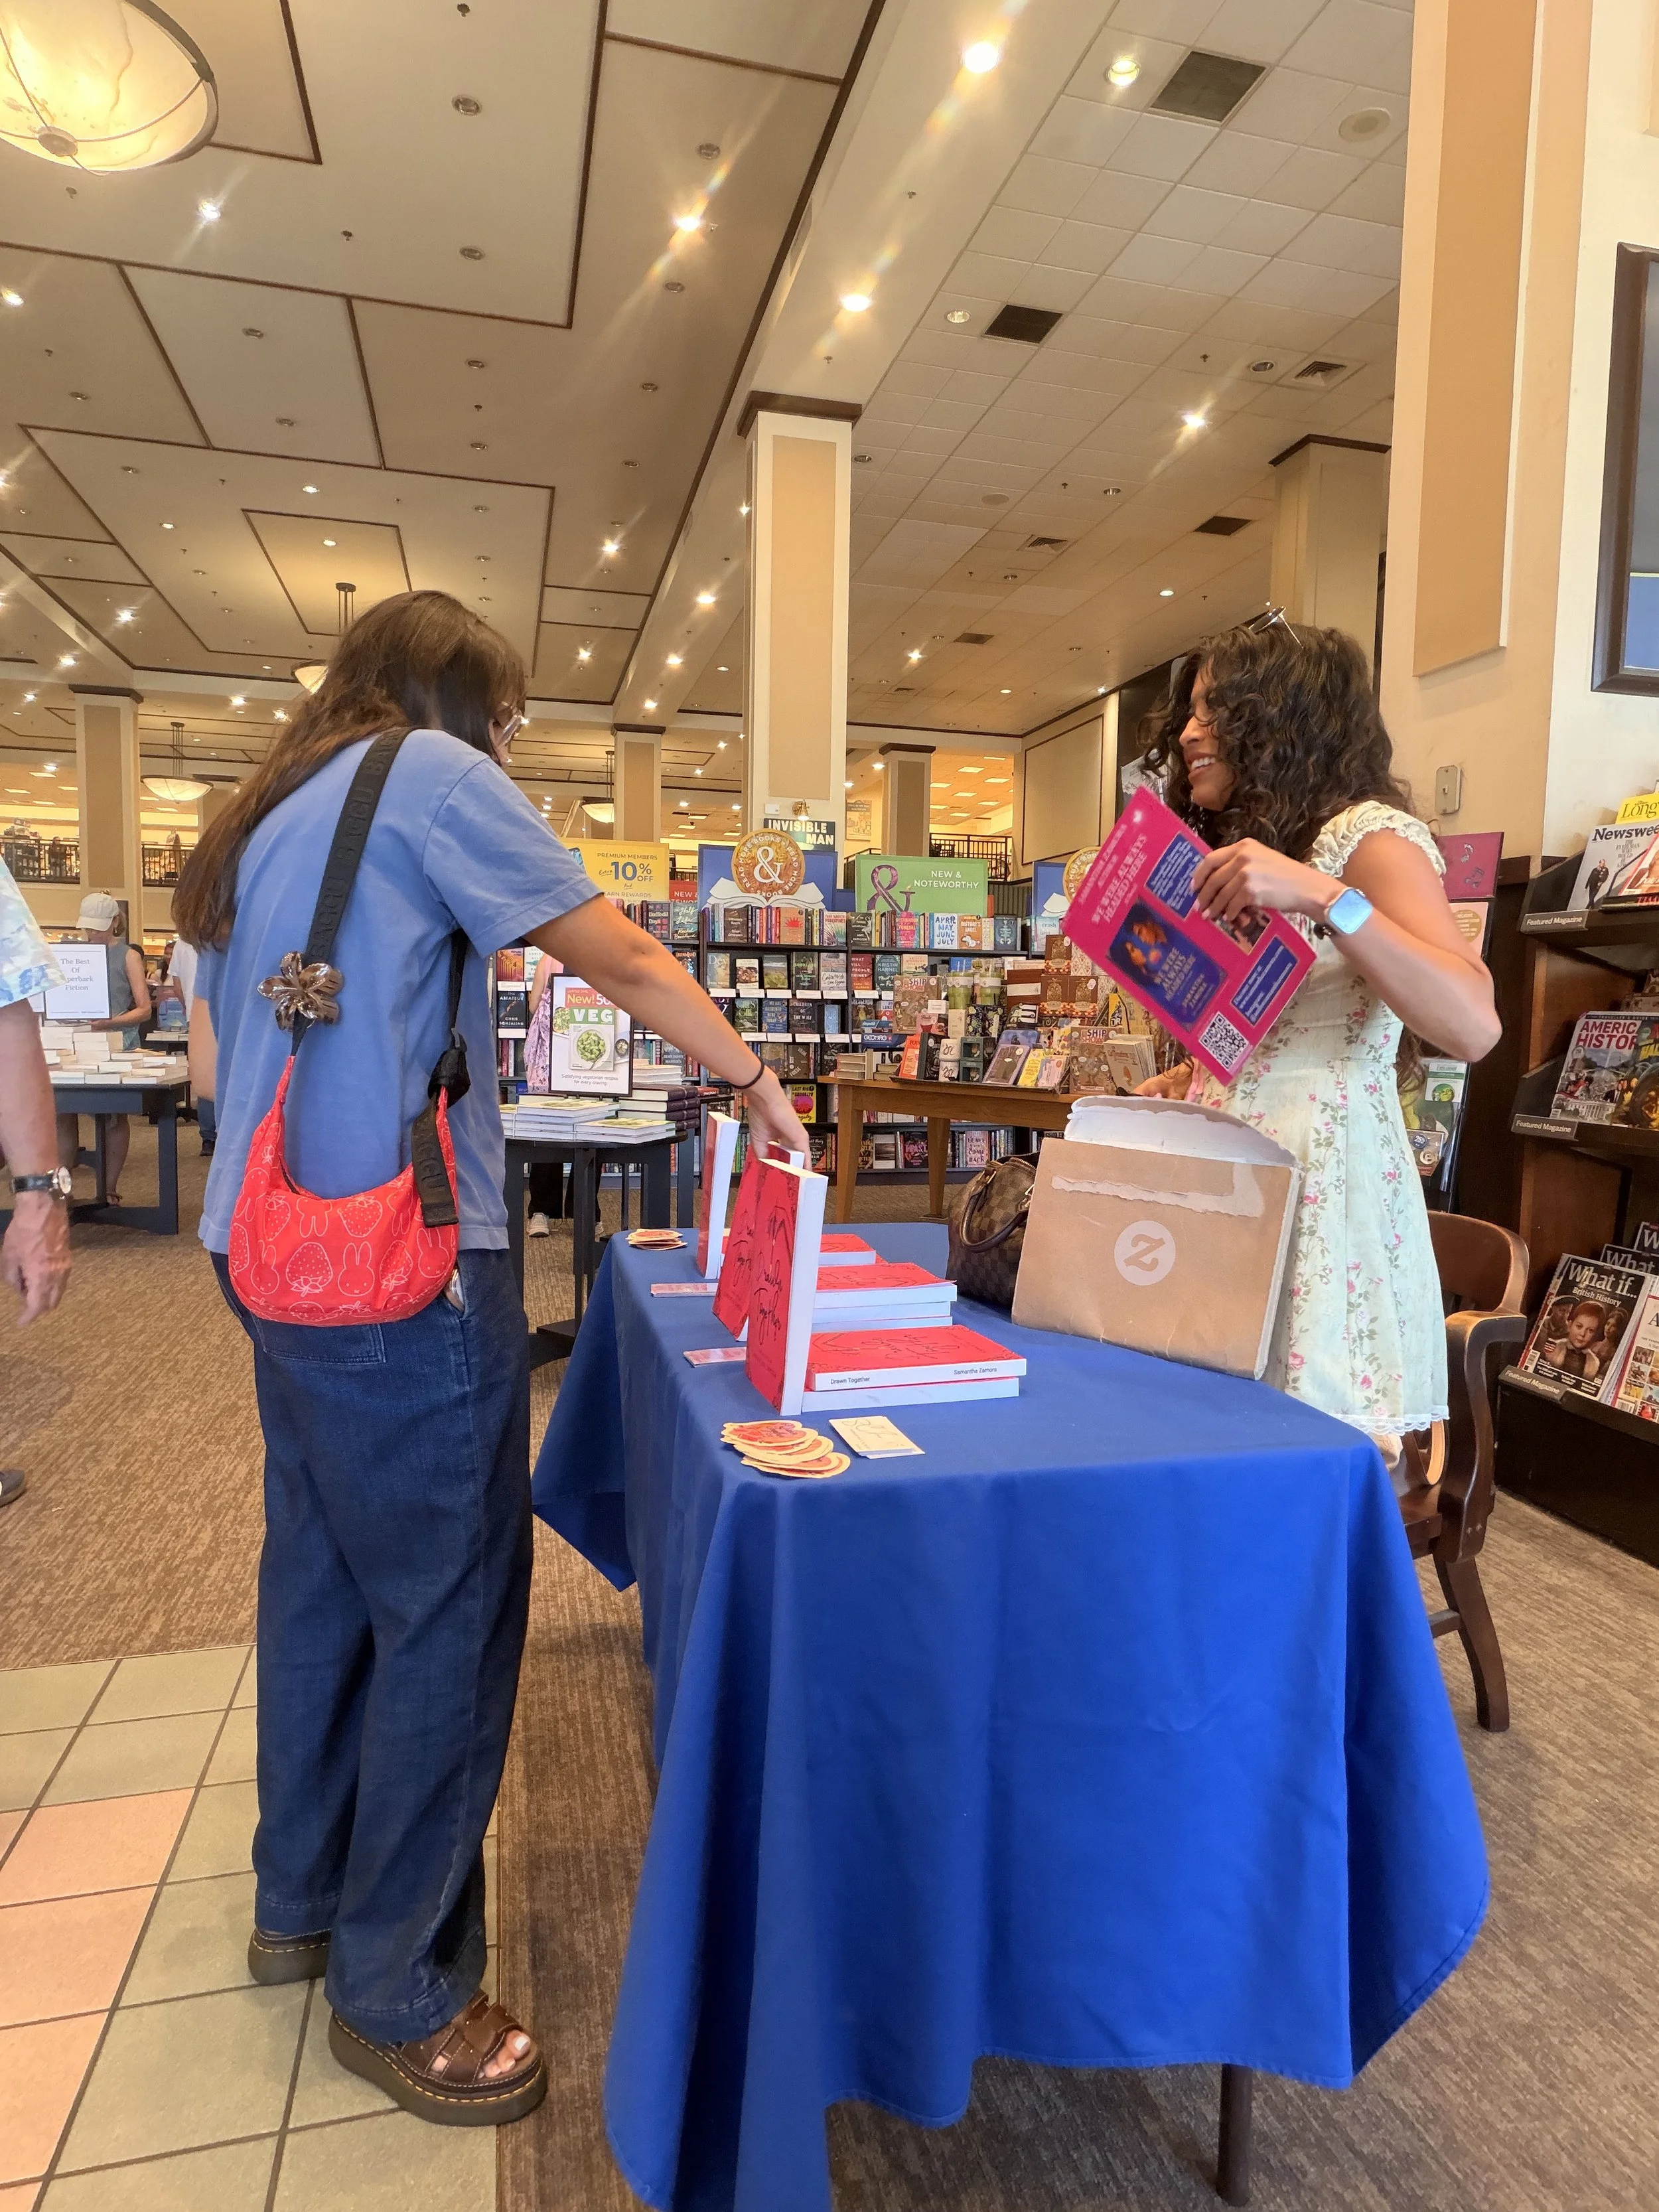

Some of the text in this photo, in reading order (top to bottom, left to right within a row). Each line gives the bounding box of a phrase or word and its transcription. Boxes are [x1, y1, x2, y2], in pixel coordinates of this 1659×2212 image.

[768, 819, 827, 834] INVISIBLE
[1592, 824, 1659, 842] Newswee
[806, 833, 833, 845] MAN
[739, 835, 781, 887] READ MORE BOOKS
[1083, 853, 1097, 861] BOO
[611, 861, 652, 881] 10%
[757, 846, 798, 898] READ MORE BOOKS
[914, 879, 979, 889] NOTEWORTHY
[679, 906, 698, 915] Half
[1527, 916, 1583, 926] Featured Magazine
[567, 994, 595, 1004] New!
[573, 1009, 613, 1022] VEG
[1516, 1120, 1571, 1133] Featured Magazine
[1569, 1262, 1616, 1291] What
[1572, 1286, 1622, 1307] British History
[1505, 1370, 1532, 1384] Featured
[1532, 1378, 1560, 1394] Magazine
